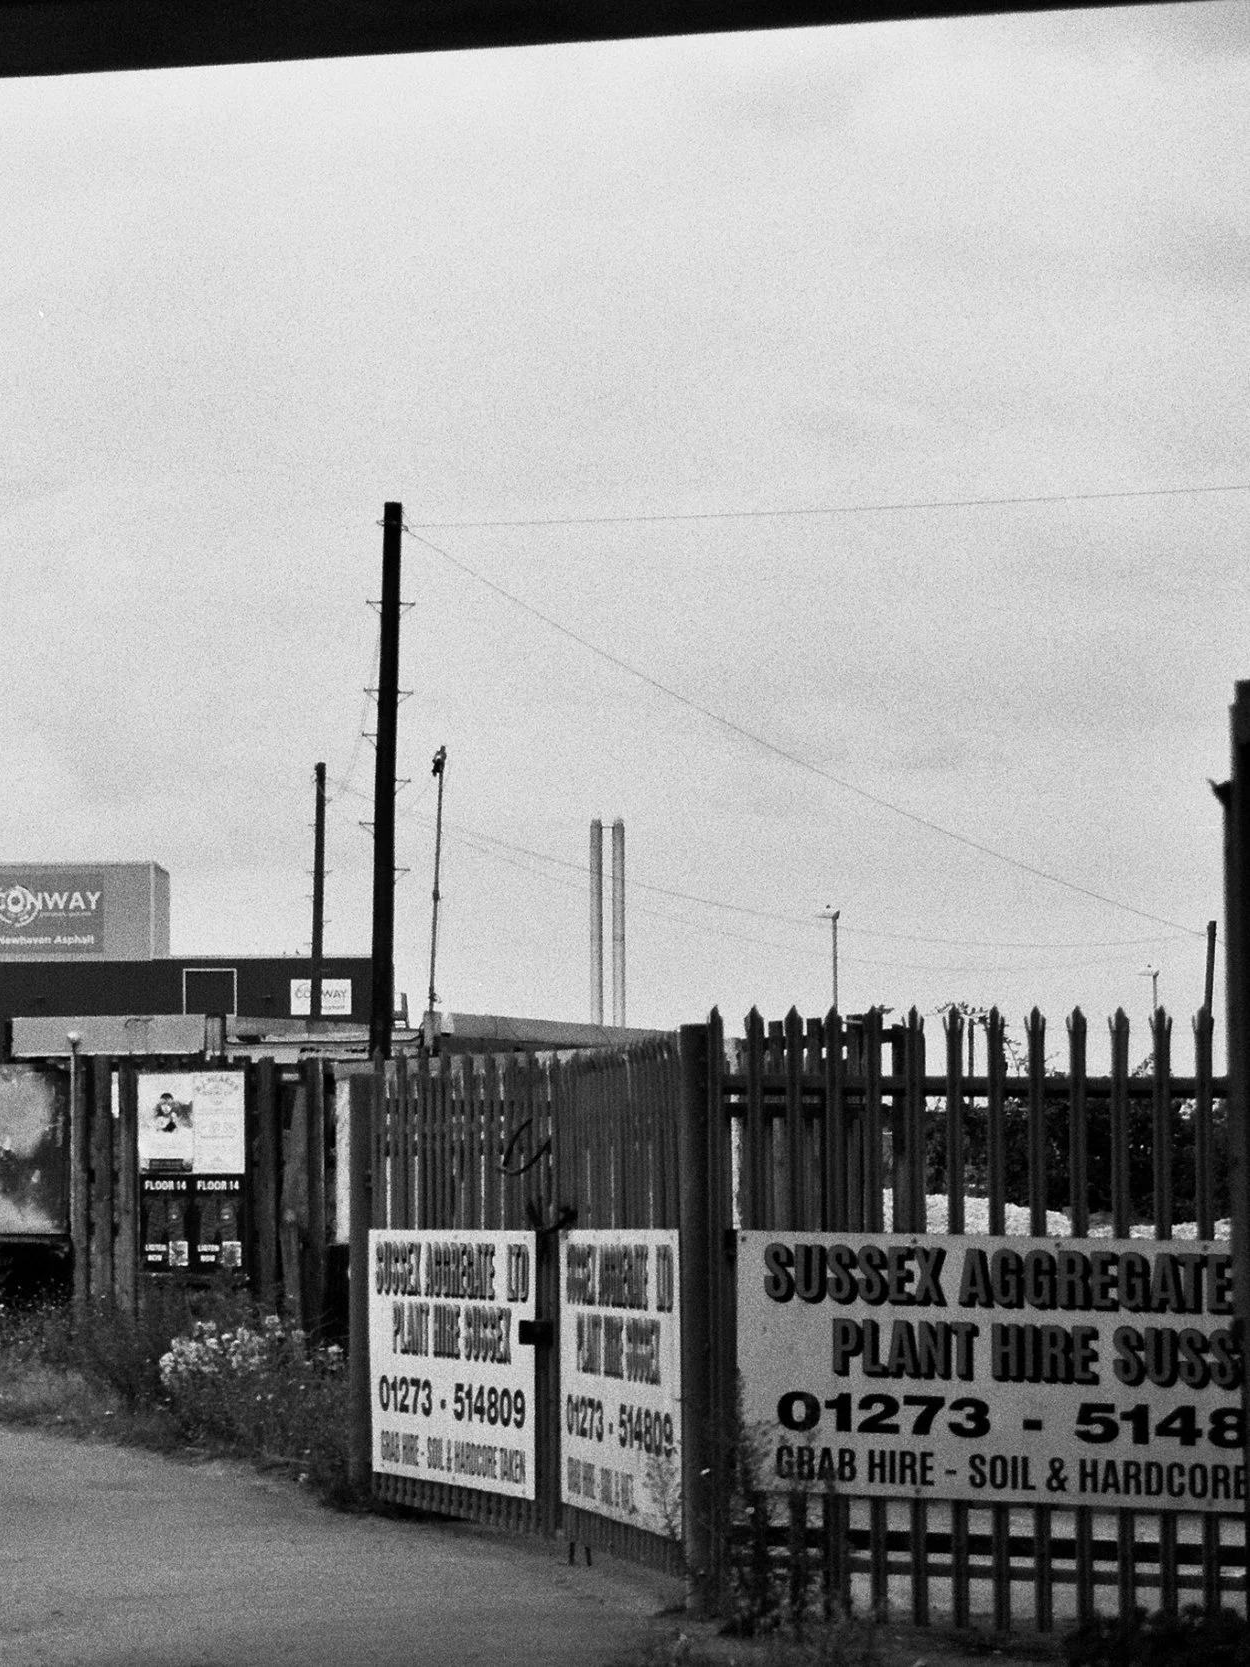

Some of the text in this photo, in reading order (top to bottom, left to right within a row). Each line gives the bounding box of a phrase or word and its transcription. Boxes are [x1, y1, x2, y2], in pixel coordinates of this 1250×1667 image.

[53, 935, 95, 945] Asphalt
[295, 988, 347, 999] COWAY
[145, 1180, 187, 1191] FLOOR 14
[196, 1180, 240, 1191] FLOOR 14
[763, 1242, 1234, 1316] SUSSEX AGGREGATE
[831, 1318, 980, 1381] PLANT
[990, 1322, 1100, 1386] HIRE
[379, 1375, 433, 1417] 01273
[453, 1382, 526, 1429] 514809
[566, 1393, 605, 1443] 01273
[618, 1403, 674, 1459] 514809
[777, 1391, 991, 1438] 01273
[1075, 1403, 1247, 1449] 5148
[777, 1445, 857, 1482] GRAB
[868, 1449, 935, 1486] HIRE
[969, 1454, 1037, 1491] SOIL
[1046, 1456, 1069, 1493] &
